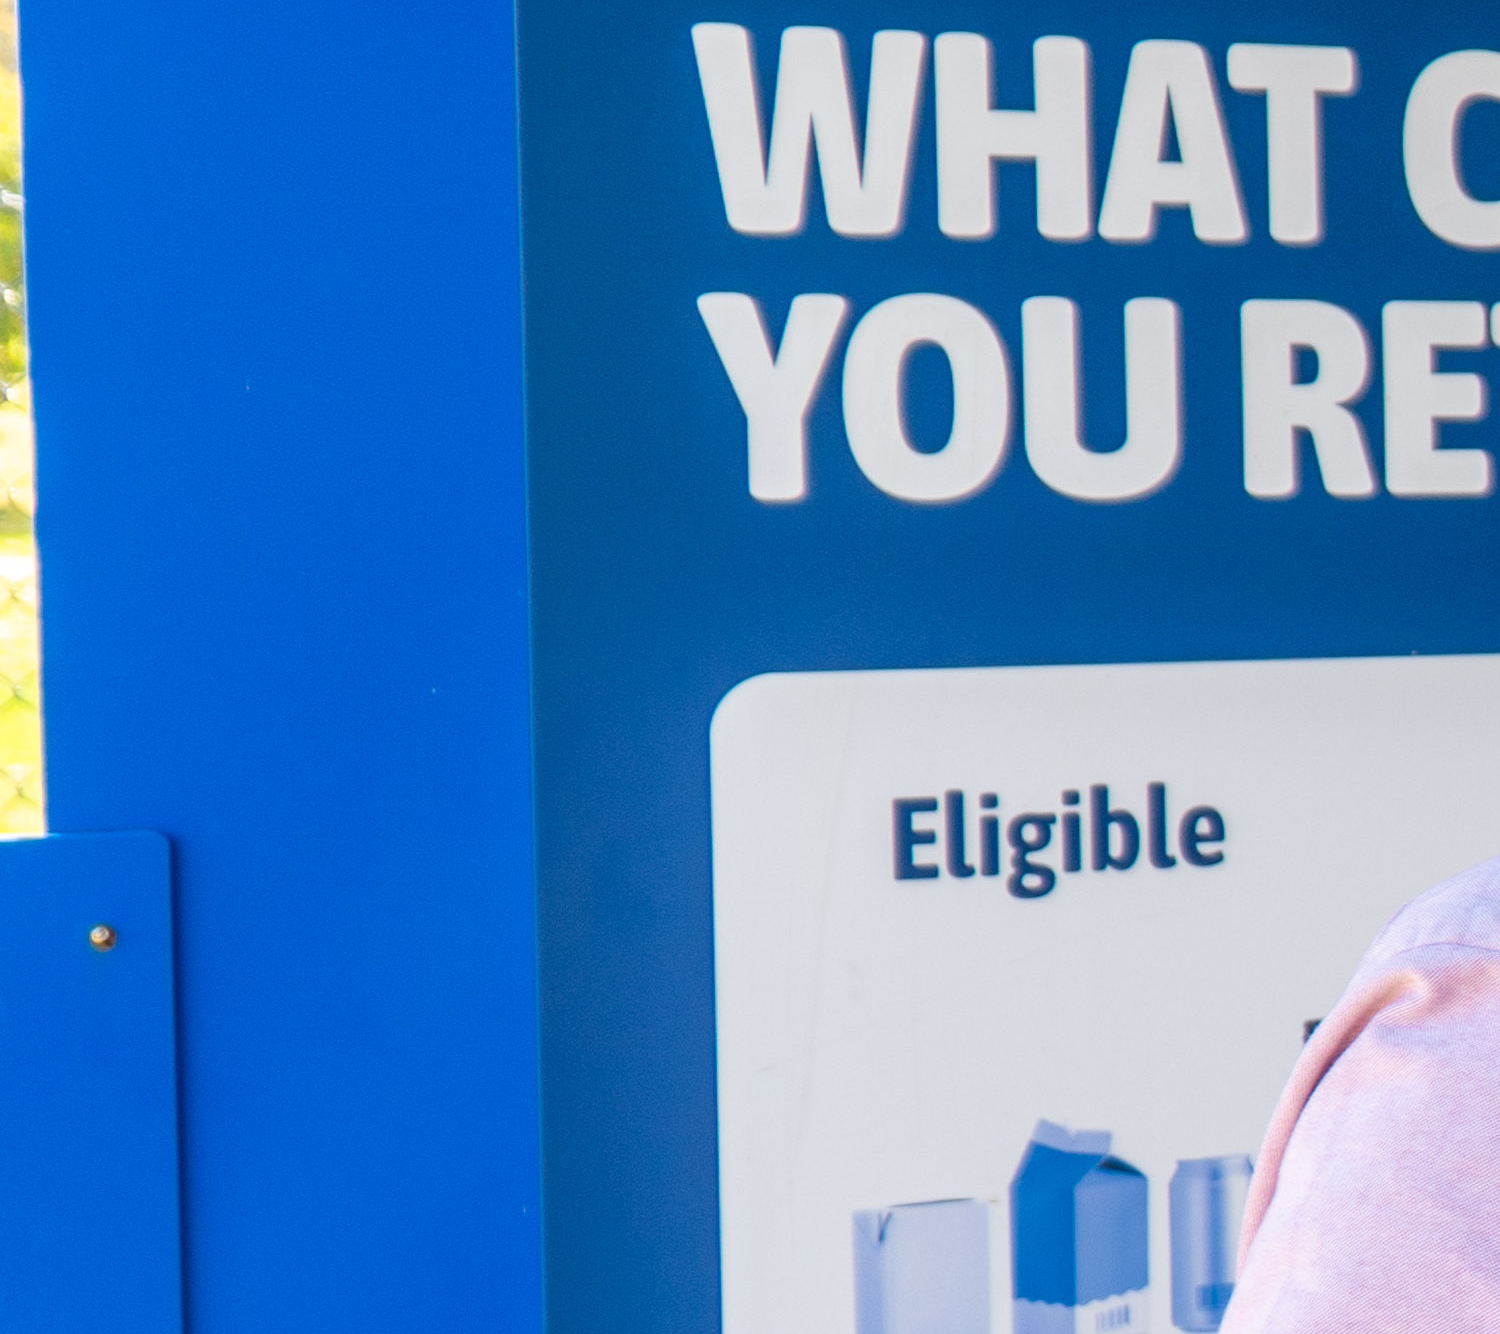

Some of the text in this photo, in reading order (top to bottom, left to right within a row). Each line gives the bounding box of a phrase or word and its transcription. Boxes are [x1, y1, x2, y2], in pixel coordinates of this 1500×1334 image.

[691, 21, 1357, 247] WHAT
[696, 291, 1181, 503] YOU
[893, 782, 1226, 900] Eligible
